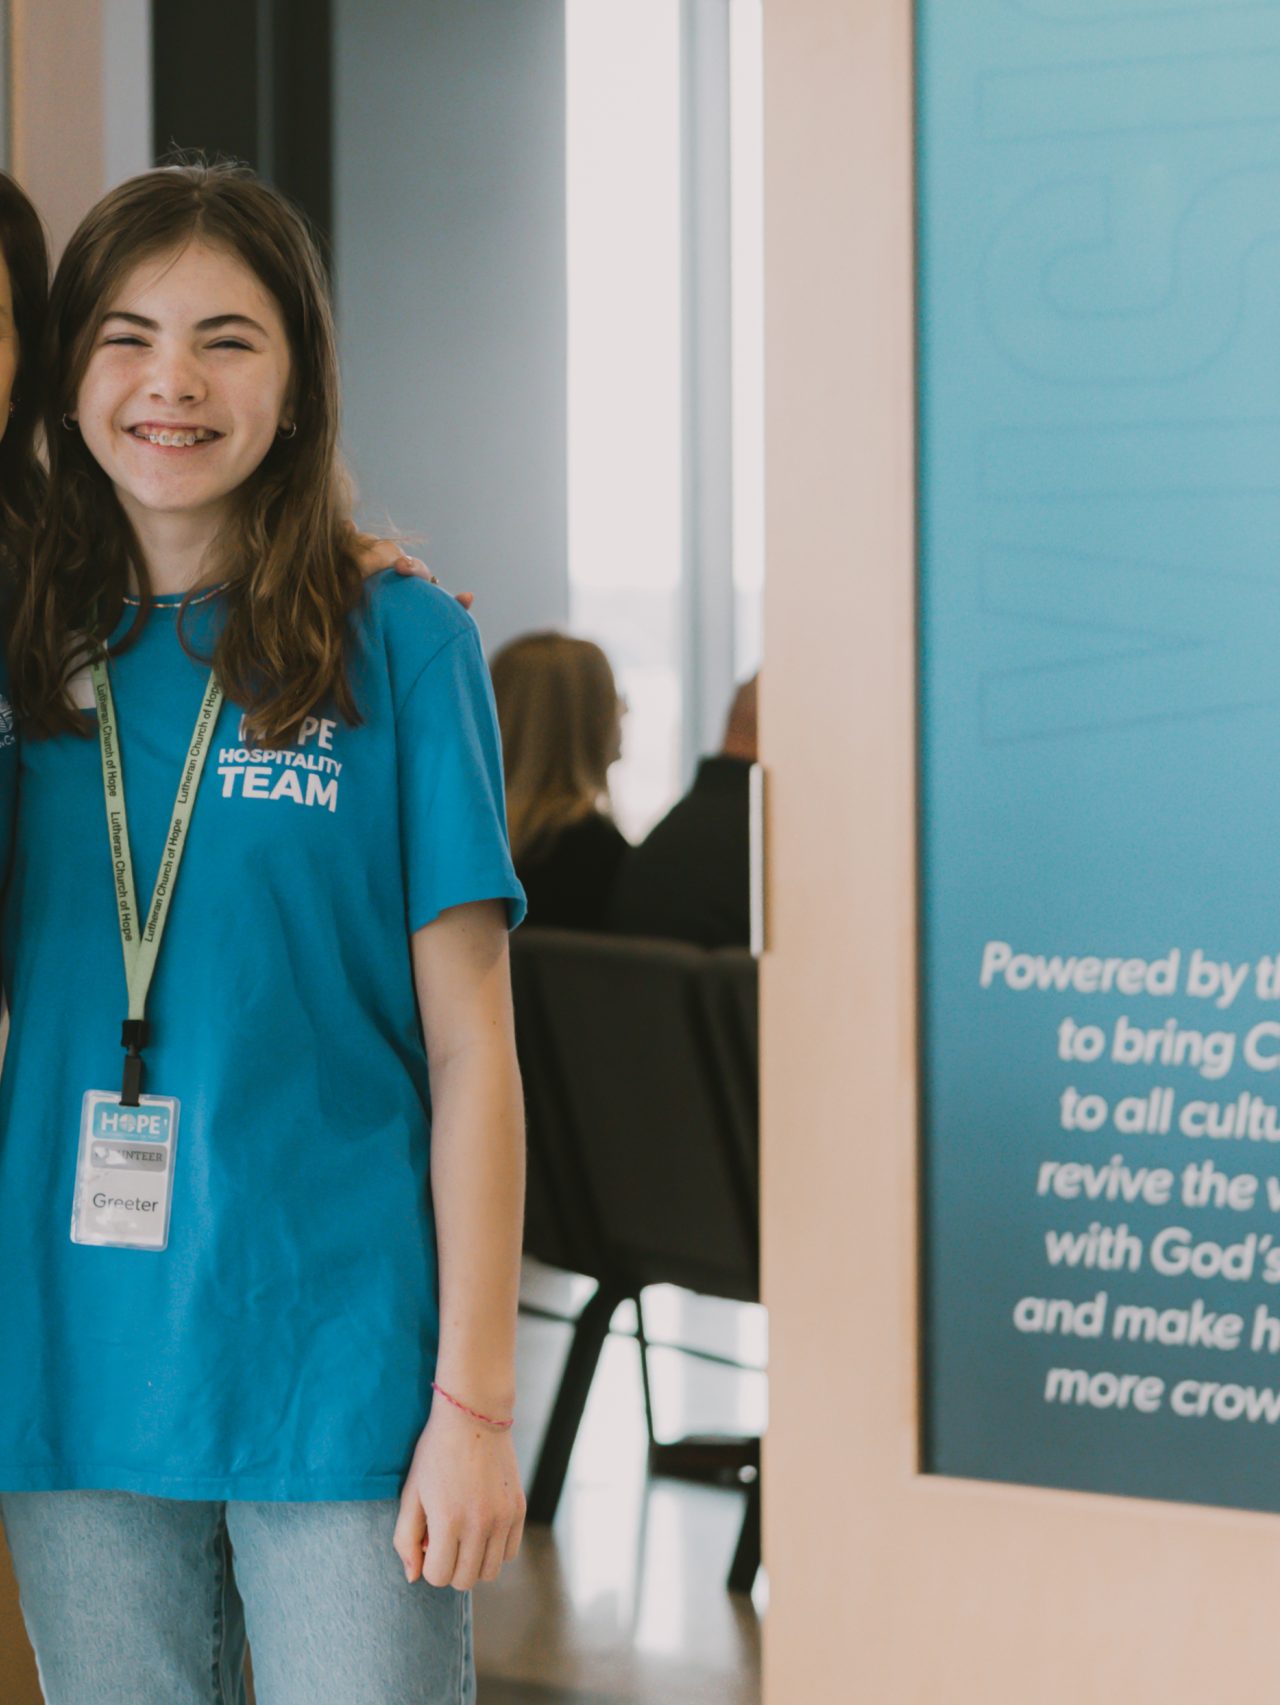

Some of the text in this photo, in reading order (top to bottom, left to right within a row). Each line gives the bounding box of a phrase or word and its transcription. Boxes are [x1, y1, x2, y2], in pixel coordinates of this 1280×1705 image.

[976, 0, 1280, 748] VISI
[96, 684, 117, 797] Lutheran Church of Hope
[178, 760, 198, 804] Lutheran
[190, 721, 209, 756] Church
[203, 708, 212, 720] of
[218, 748, 343, 777] HOSPITALITY
[217, 766, 339, 813] TEAM
[110, 811, 133, 942] Lutheran Church of Hope
[144, 818, 183, 943] Lutheran Church of Hope
[979, 940, 1181, 996] Powered
[1186, 948, 1250, 1009] by
[1057, 1016, 1106, 1063] to
[1111, 1015, 1237, 1080] bring
[100, 1111, 161, 1135] HOPE
[1059, 1086, 1108, 1132] to
[1113, 1087, 1175, 1135] all
[92, 1193, 159, 1213] Greeter
[1036, 1153, 1174, 1206] revive
[1181, 1158, 1259, 1212] the
[1045, 1221, 1280, 1284] with God's
[1013, 1291, 1108, 1338] and
[1112, 1299, 1245, 1351] make
[1044, 1367, 1165, 1413] more
